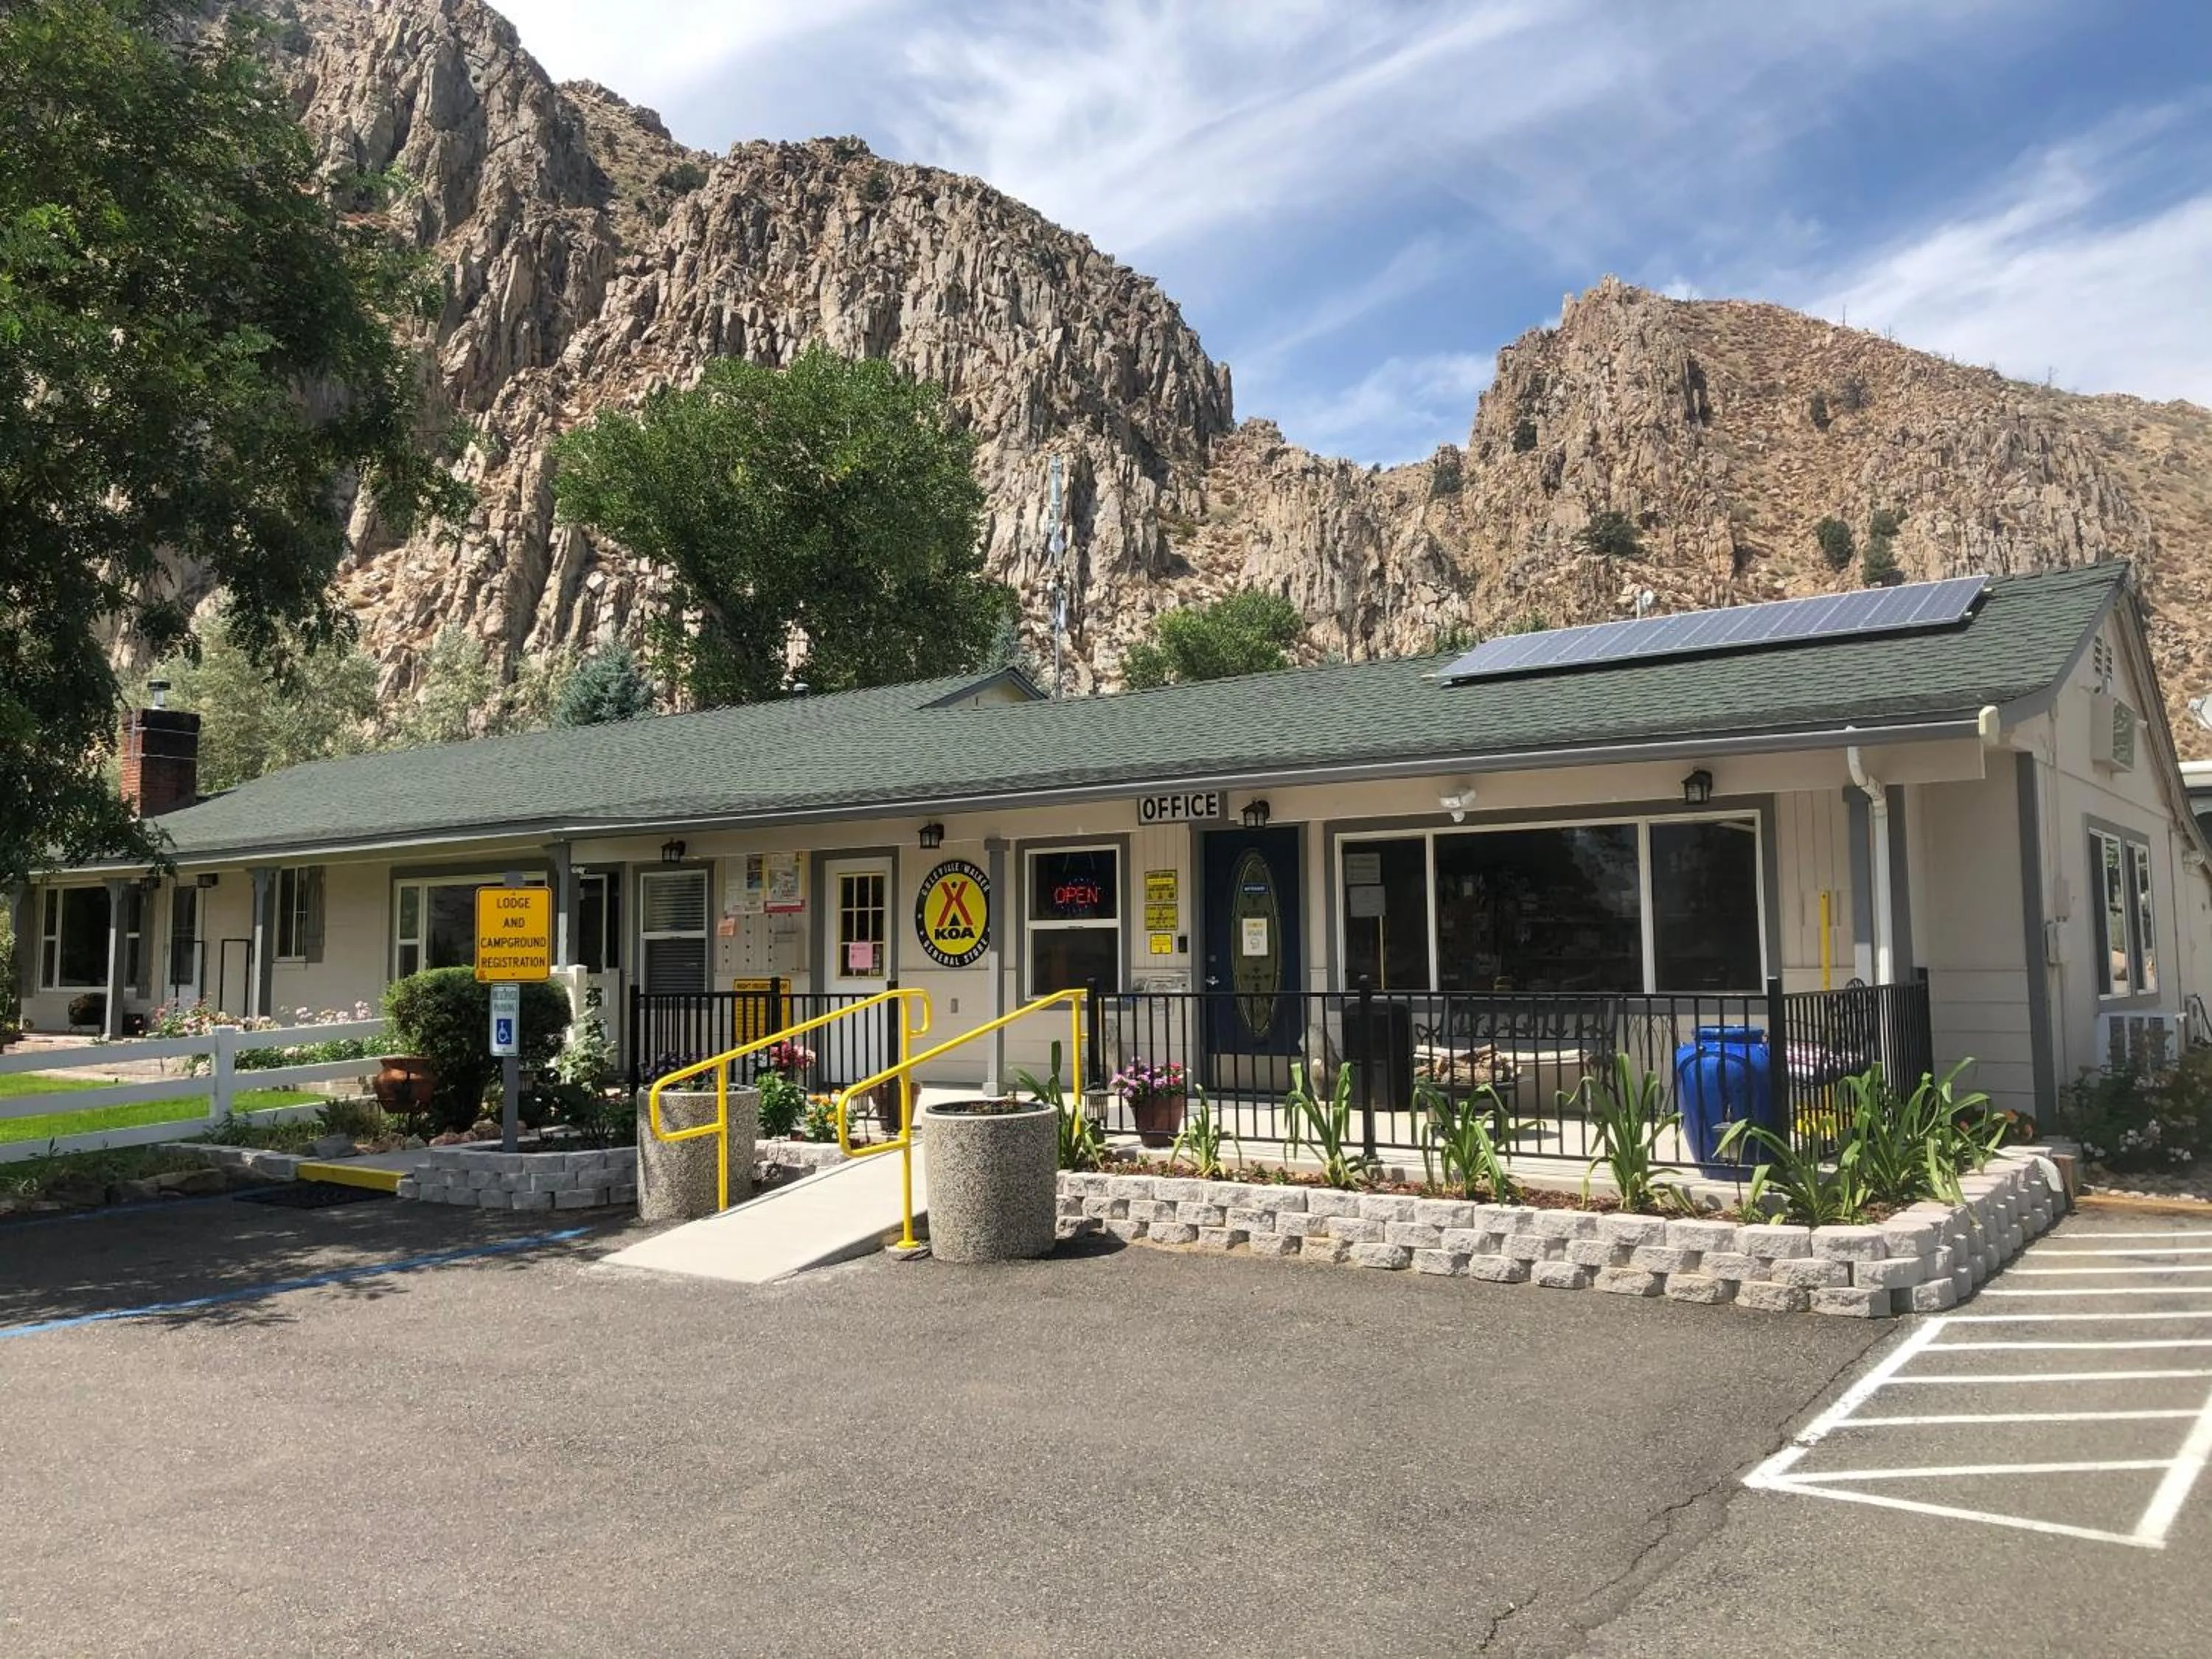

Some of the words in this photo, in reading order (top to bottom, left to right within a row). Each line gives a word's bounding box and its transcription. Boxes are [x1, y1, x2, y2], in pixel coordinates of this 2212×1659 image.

[1142, 794, 1217, 820] OFFICE
[964, 864, 990, 892] WALKER
[1054, 886, 1098, 904] OPEN
[496, 897, 531, 909] LODGE
[503, 917, 526, 928] AND
[933, 928, 975, 940] KOA
[480, 936, 546, 949] CAMPGROUND
[924, 939, 960, 967] GENERAL
[963, 938, 988, 964] STORE
[481, 956, 546, 968] REGISTRATION
